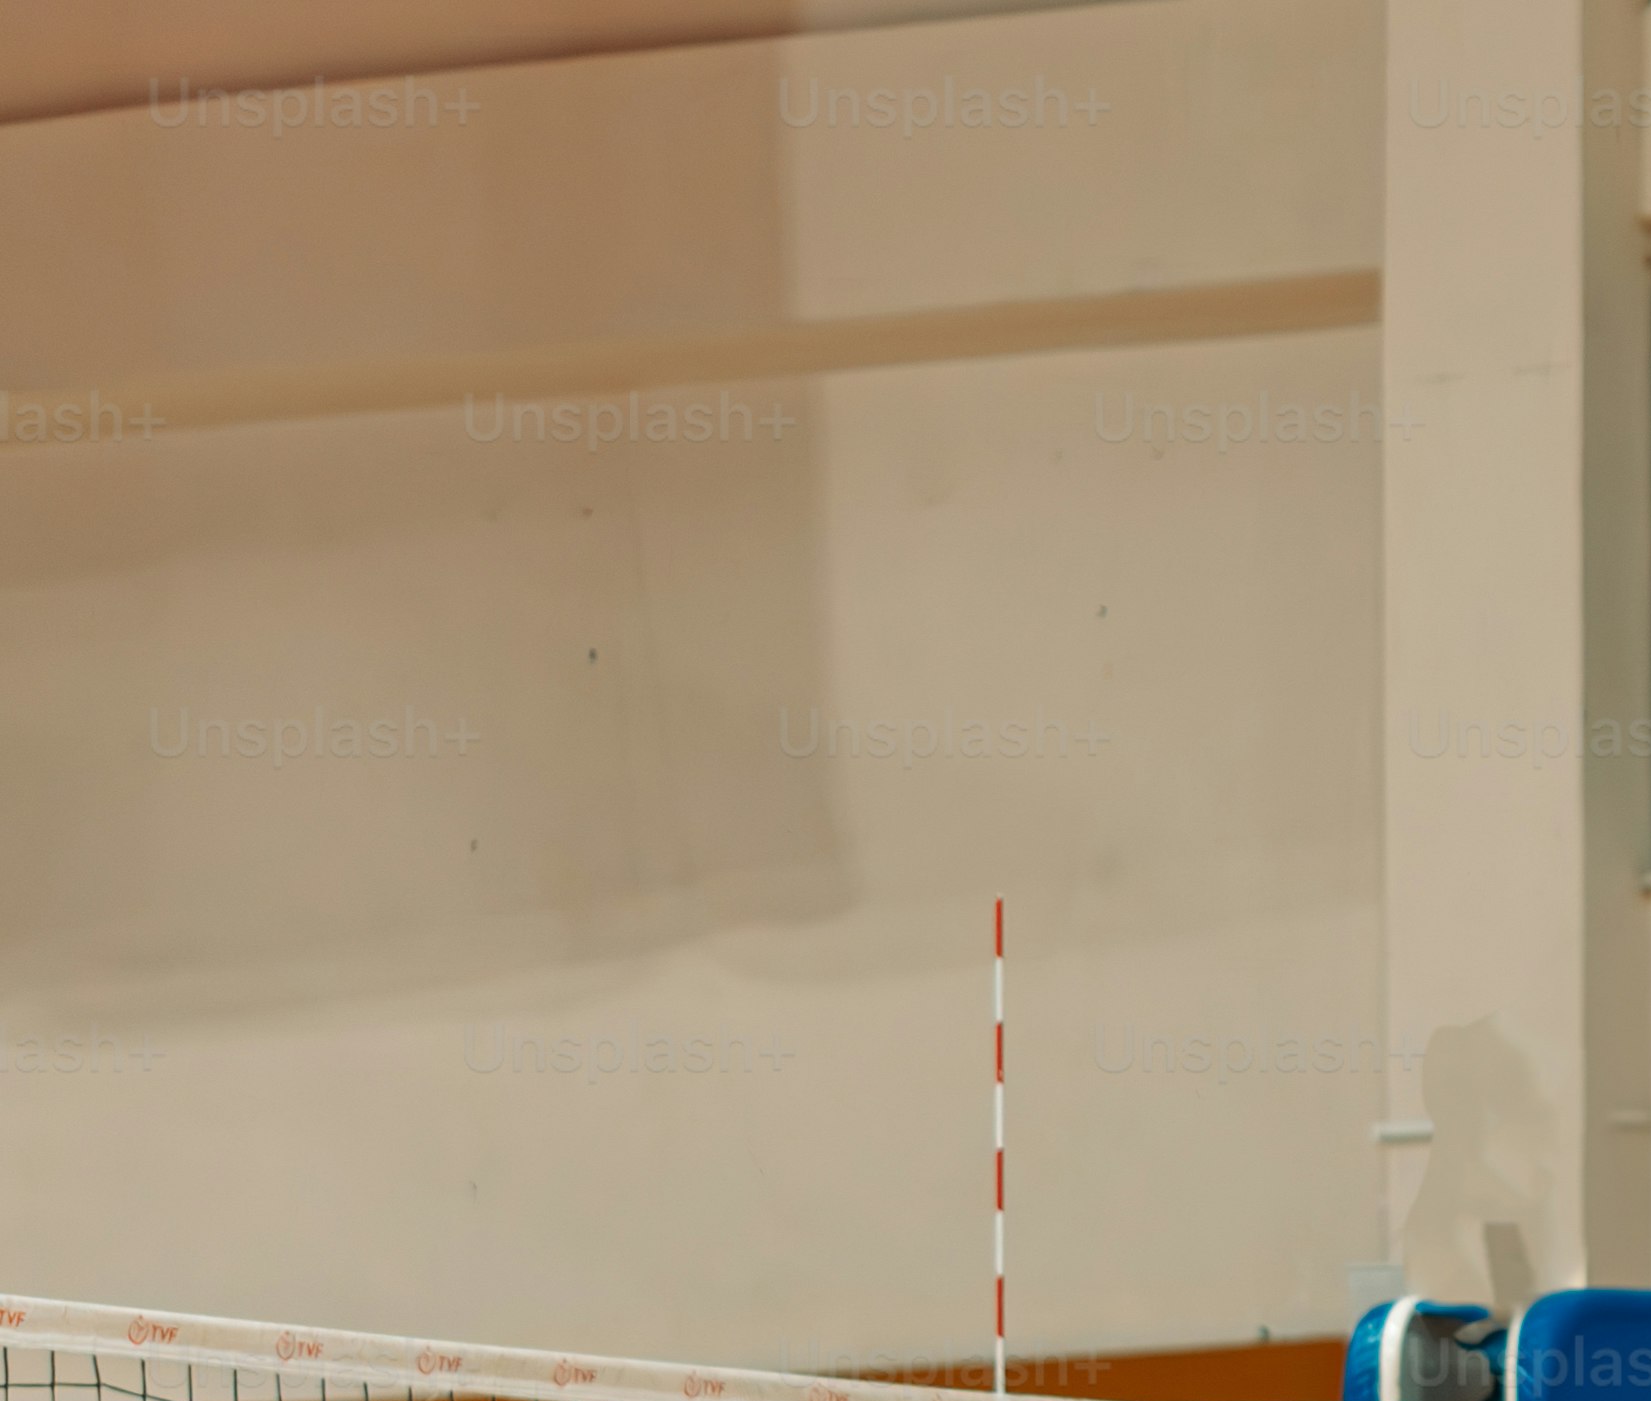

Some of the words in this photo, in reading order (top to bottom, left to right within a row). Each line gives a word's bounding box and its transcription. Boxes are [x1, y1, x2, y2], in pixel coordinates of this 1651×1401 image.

[151, 1323, 179, 1342] TVF
[299, 1341, 324, 1358] TVF
[438, 1356, 463, 1372] TVF
[574, 1368, 597, 1384] TVF
